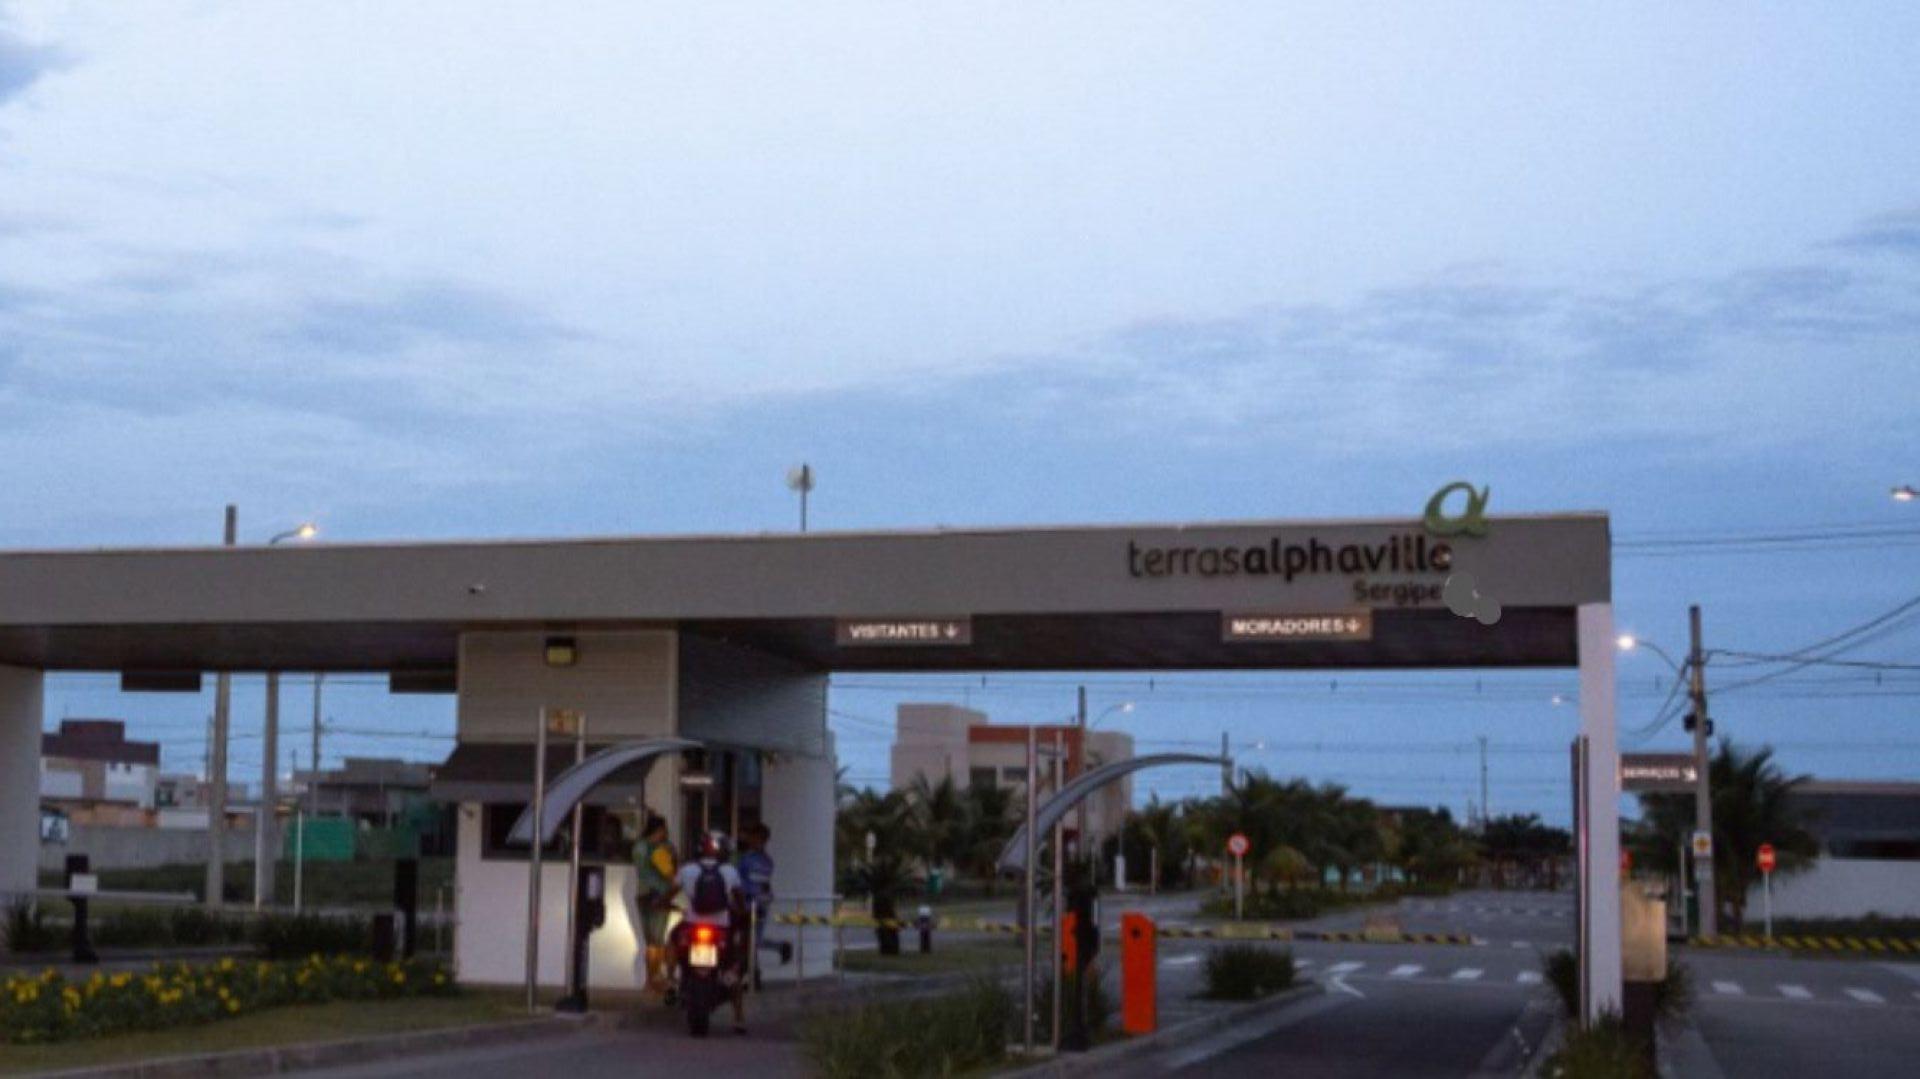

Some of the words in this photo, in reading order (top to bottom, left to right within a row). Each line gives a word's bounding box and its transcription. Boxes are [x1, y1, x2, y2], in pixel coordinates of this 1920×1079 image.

[1353, 578, 1442, 605] Sergipe
[848, 622, 939, 639] VISITANTES
[1231, 617, 1344, 635] MORADORES
